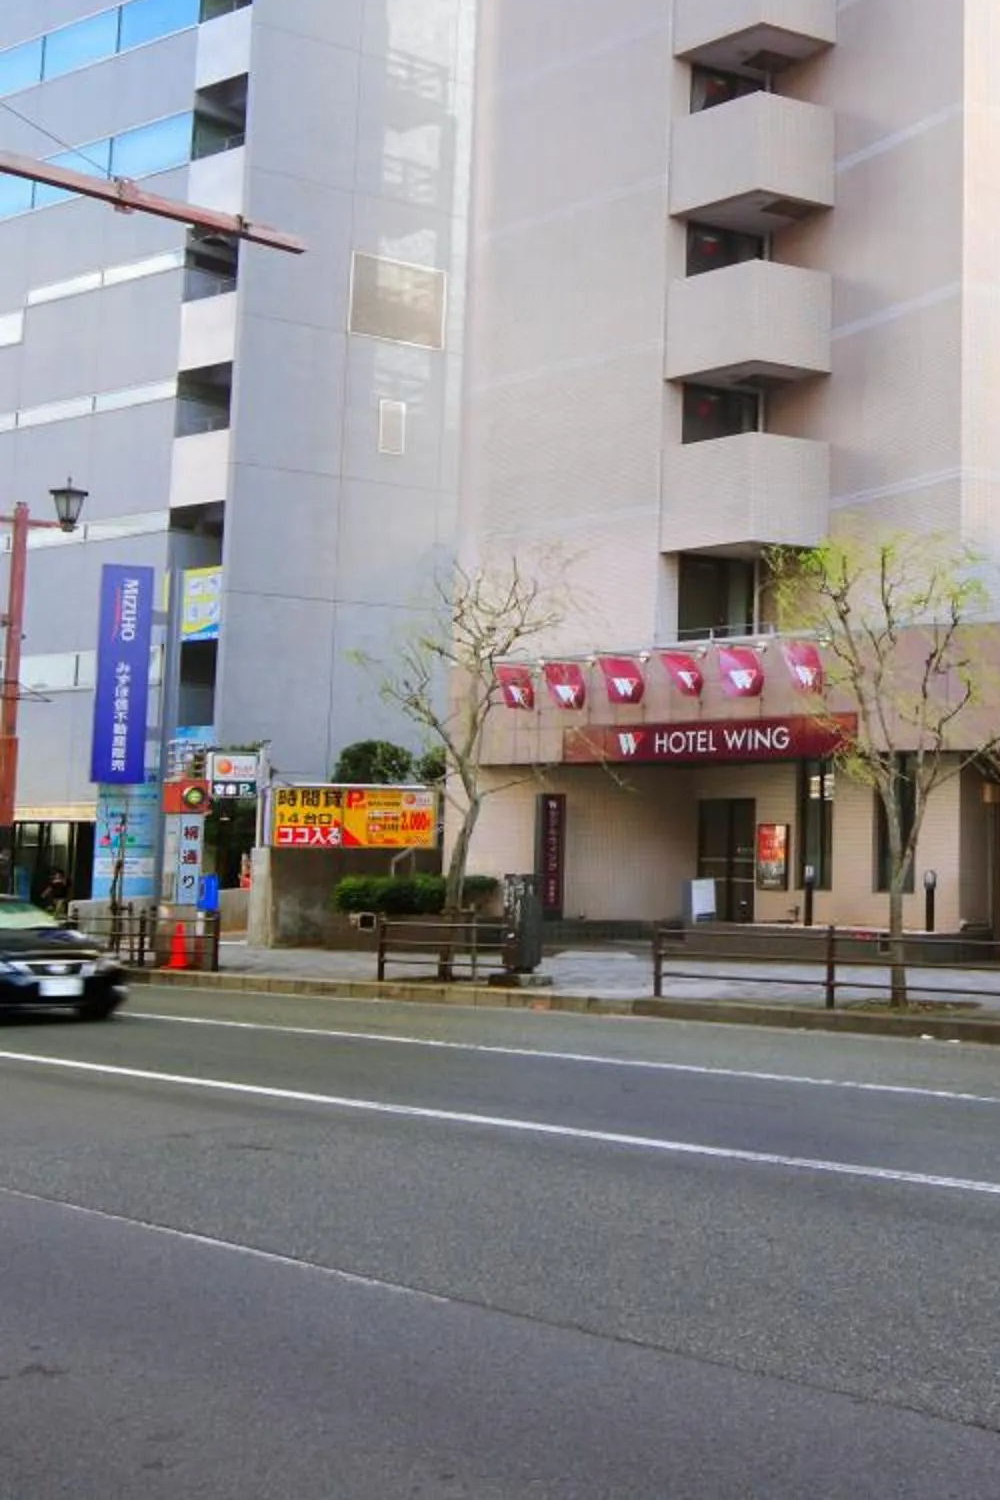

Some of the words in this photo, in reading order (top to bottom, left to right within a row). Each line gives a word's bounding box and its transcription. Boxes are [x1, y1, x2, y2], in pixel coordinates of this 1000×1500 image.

[121, 578, 138, 641] MIZUHO
[655, 730, 717, 754] HOTEL
[723, 727, 791, 750] WING
